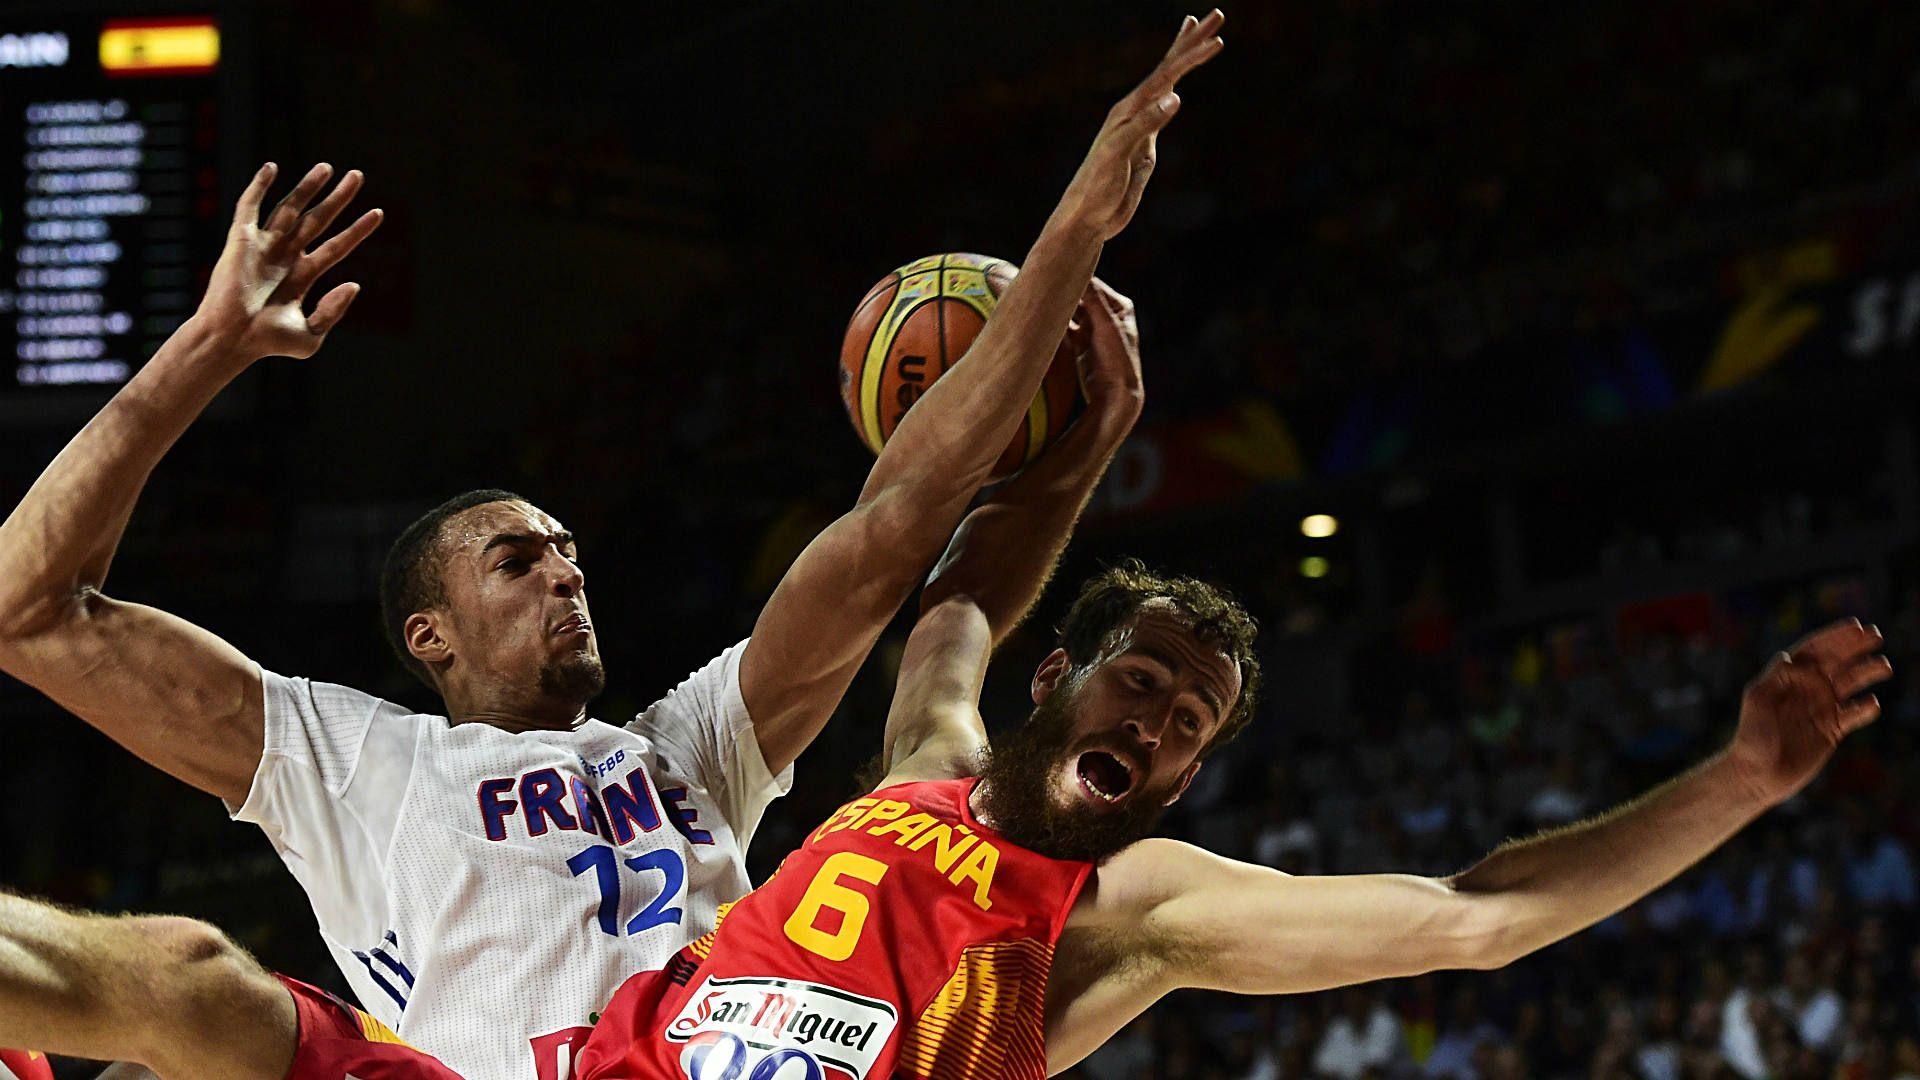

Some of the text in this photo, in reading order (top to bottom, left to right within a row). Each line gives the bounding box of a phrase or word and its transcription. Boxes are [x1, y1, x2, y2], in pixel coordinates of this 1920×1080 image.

[894, 355, 927, 422] en
[478, 767, 716, 846] FRANE
[566, 845, 684, 937] 12
[813, 798, 1000, 912] ESPAÑA
[783, 851, 889, 962] 6
[676, 991, 878, 1052] San Miguel
